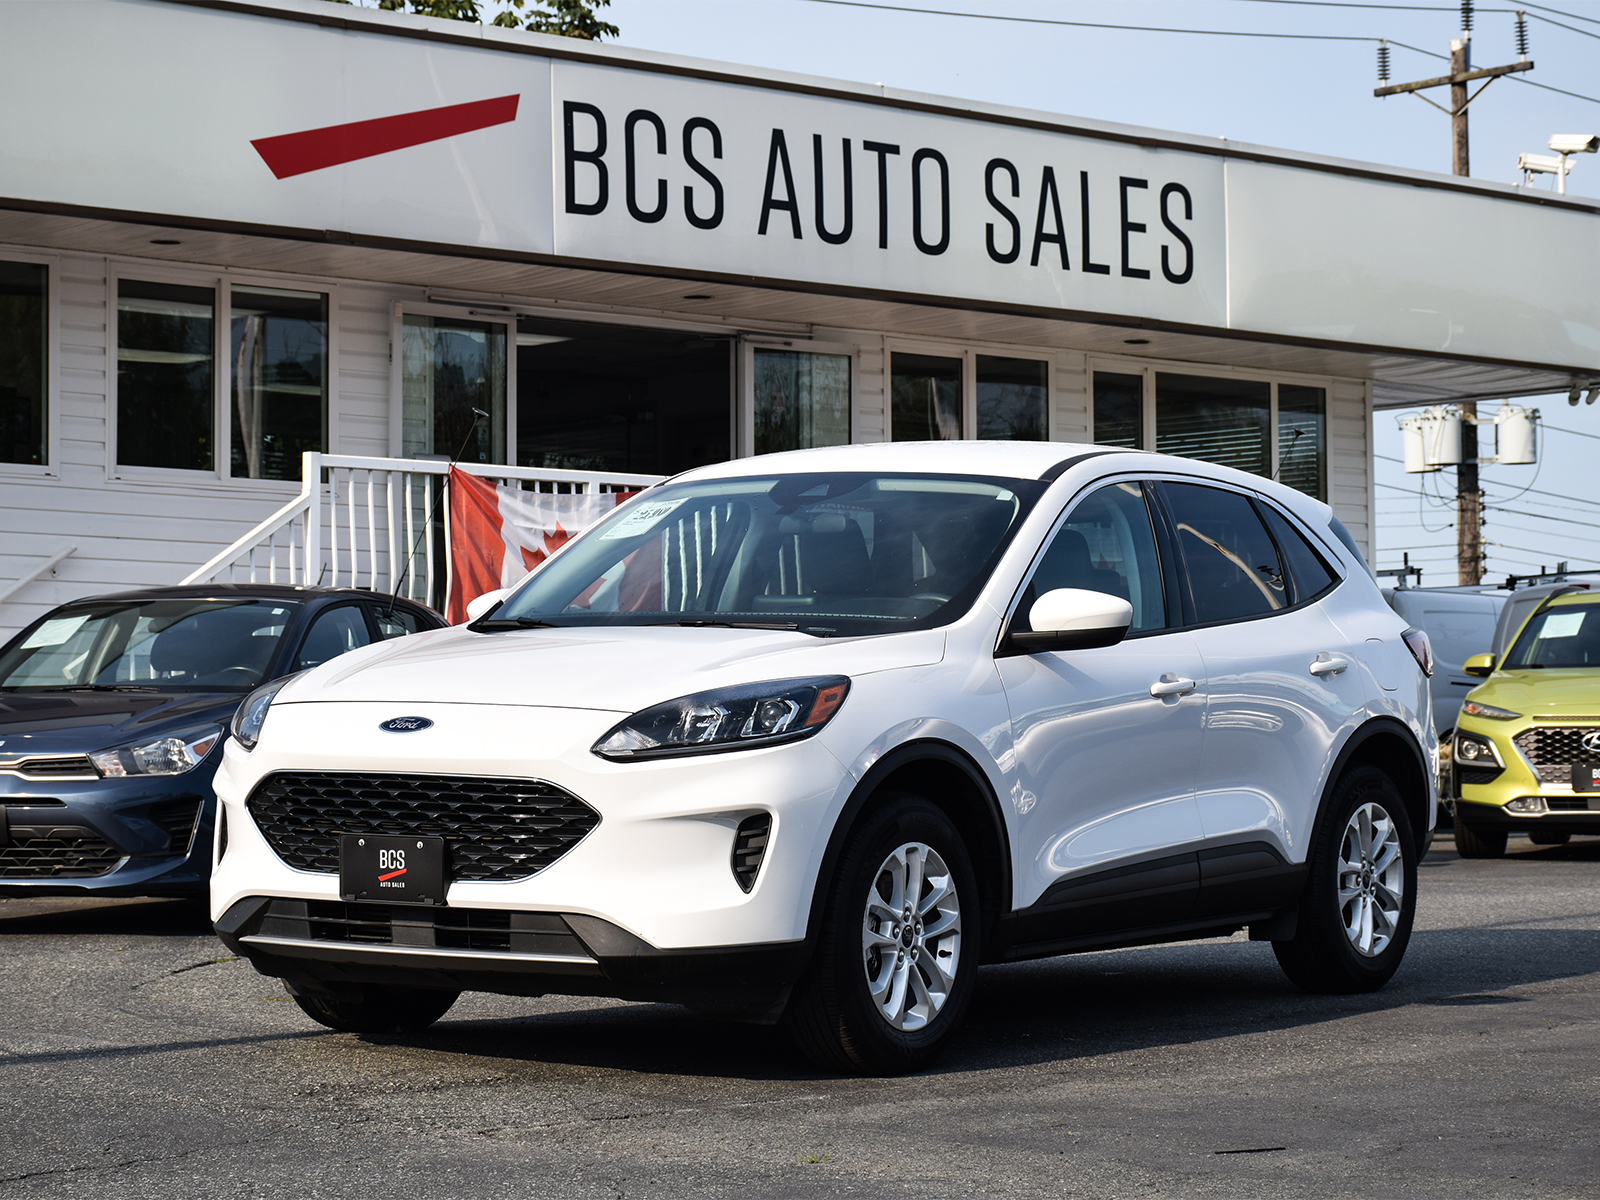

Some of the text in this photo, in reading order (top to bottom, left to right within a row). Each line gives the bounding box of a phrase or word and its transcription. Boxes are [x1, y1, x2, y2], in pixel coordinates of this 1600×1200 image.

[562, 100, 1194, 285] BCS AUTO SALES
[389, 718, 421, 729] Ford
[379, 849, 406, 870] BCS
